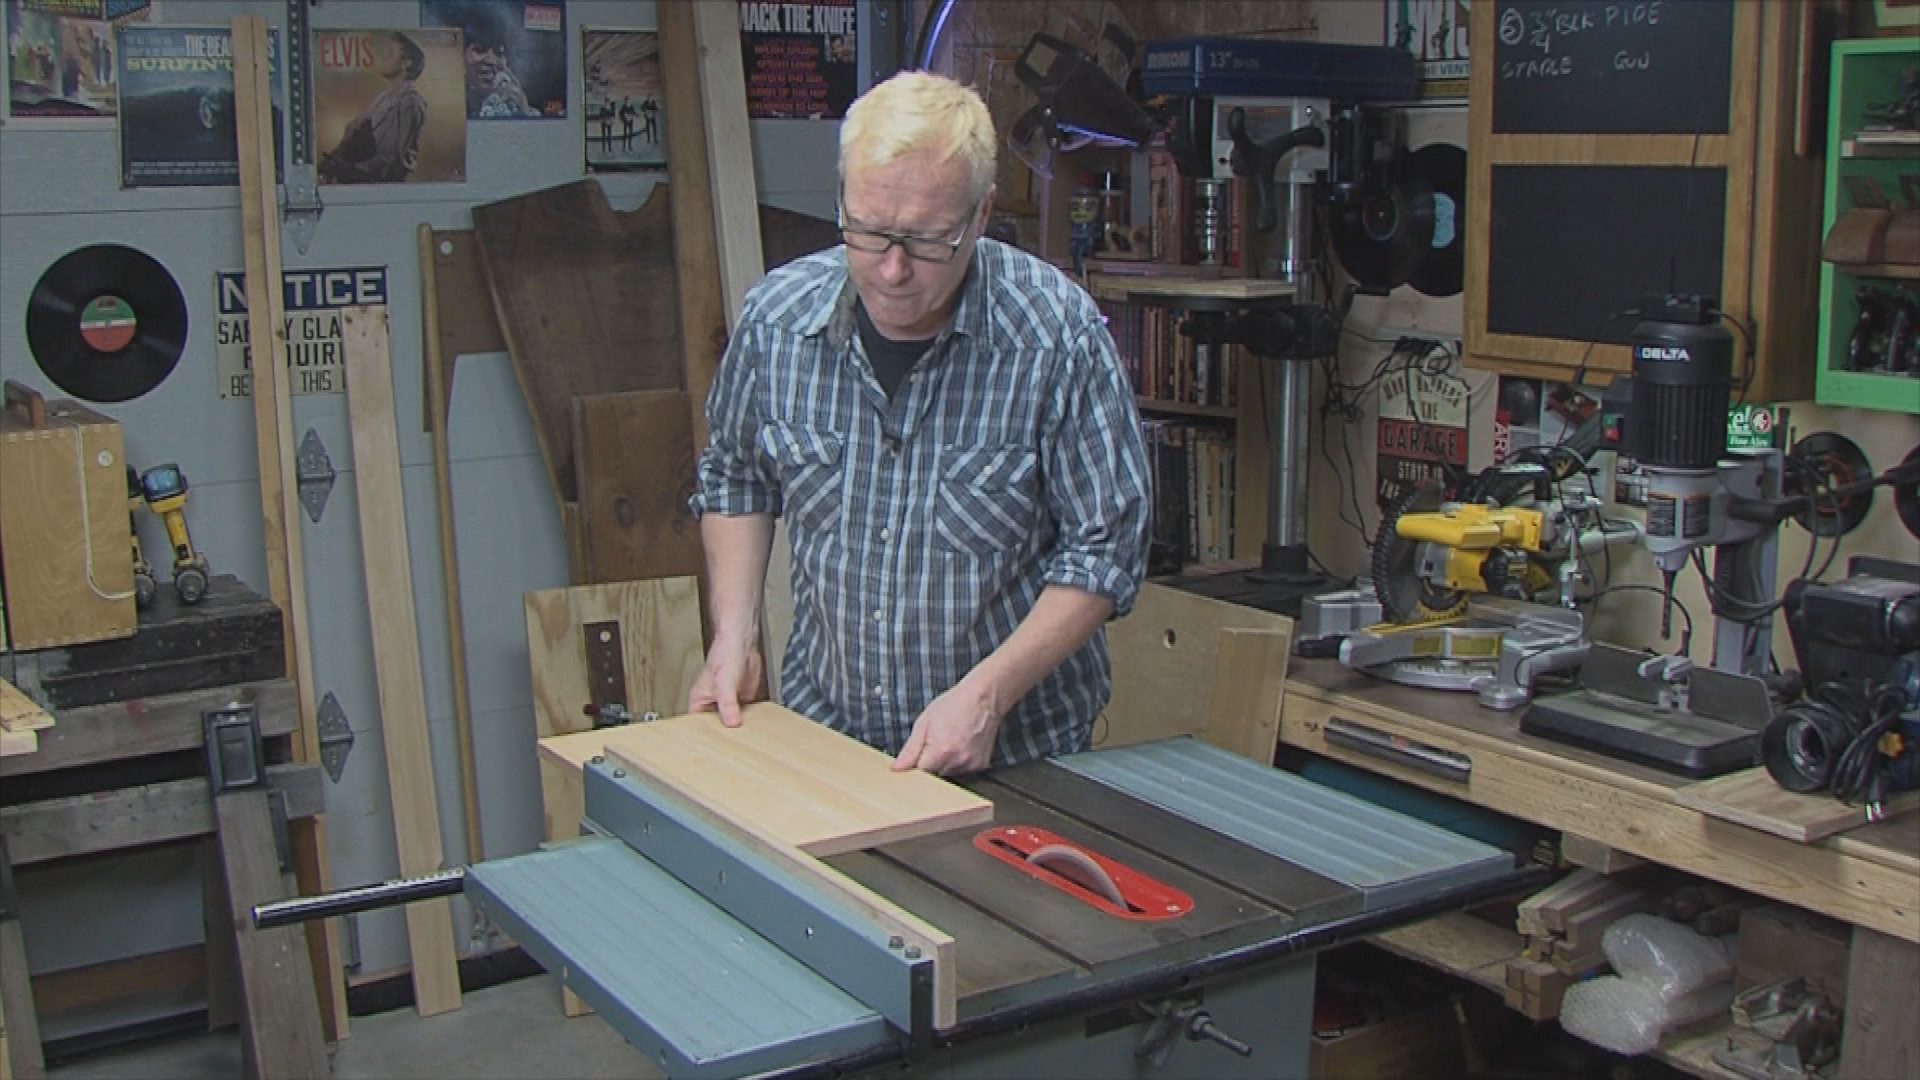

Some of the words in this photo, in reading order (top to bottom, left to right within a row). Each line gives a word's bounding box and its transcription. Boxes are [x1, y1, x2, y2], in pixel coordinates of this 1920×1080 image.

[782, 4, 812, 32] THE
[813, 6, 855, 34] KNIFE
[185, 36, 206, 56] THE
[320, 36, 375, 68] ELVIS
[1613, 51, 1649, 70] GUN
[223, 271, 383, 311] NTICE
[1641, 347, 1691, 361] DELTA
[301, 370, 332, 392] THIS
[1384, 423, 1457, 457] GARAGE
